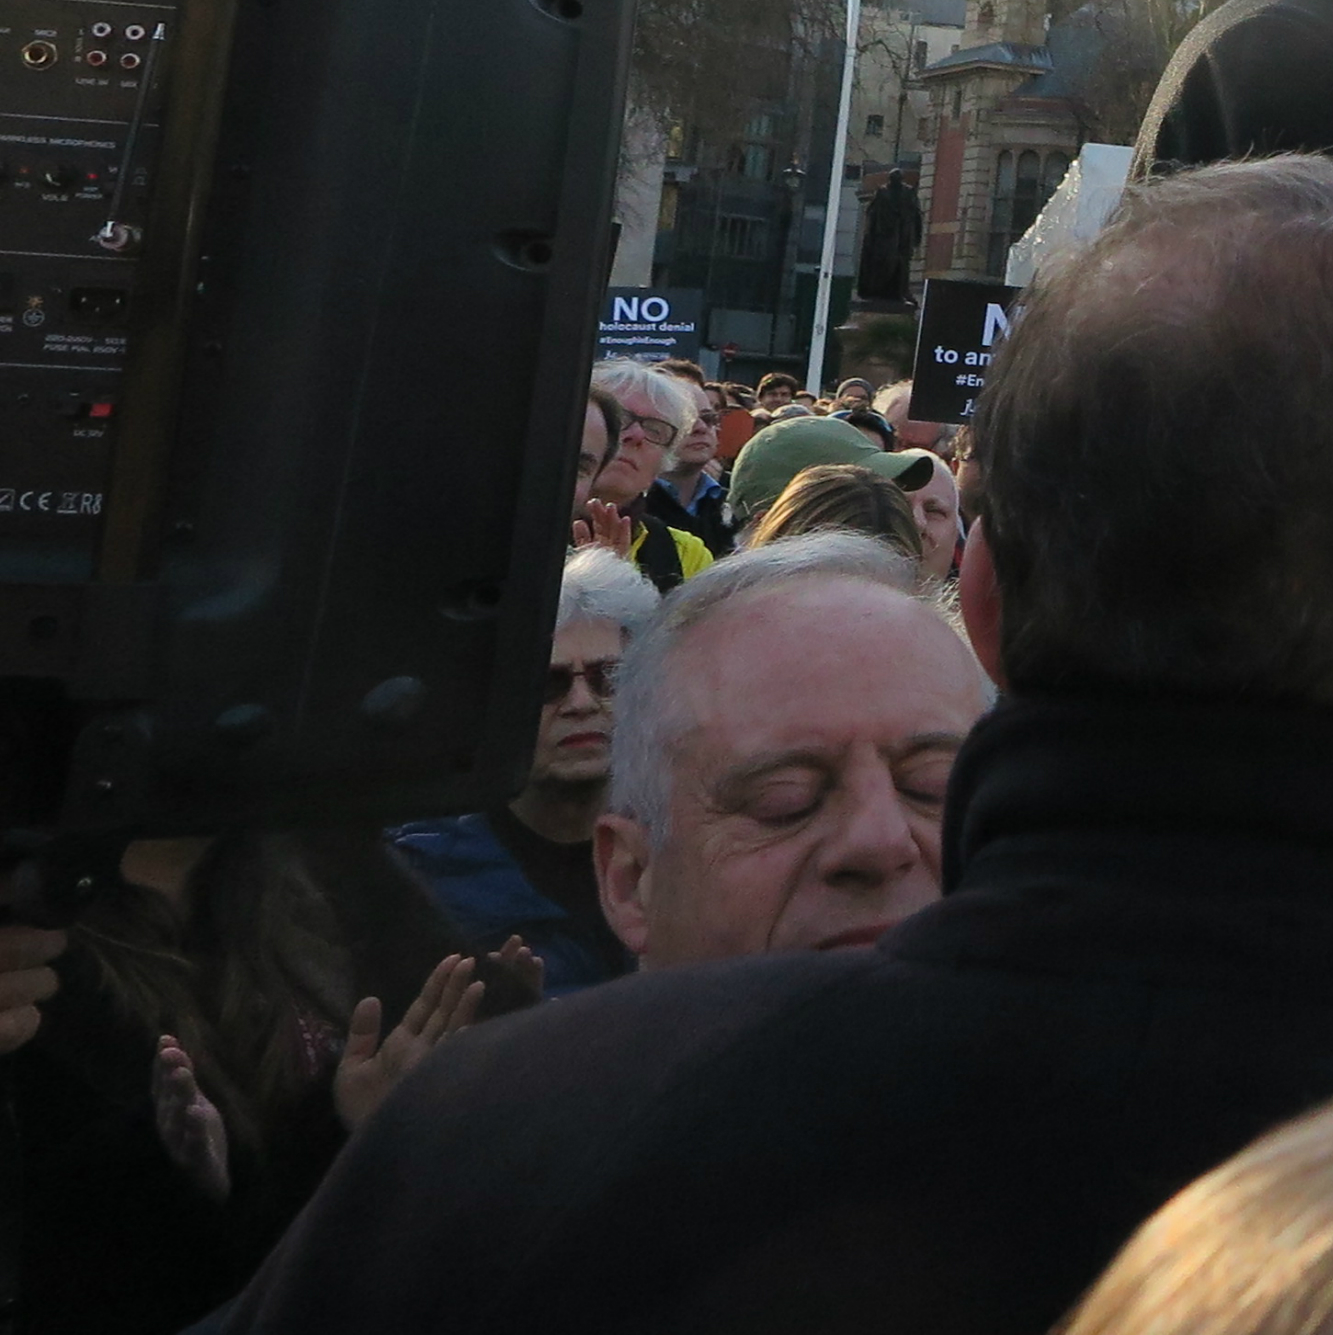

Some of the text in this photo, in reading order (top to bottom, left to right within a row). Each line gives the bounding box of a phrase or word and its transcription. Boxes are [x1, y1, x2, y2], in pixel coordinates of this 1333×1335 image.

[613, 296, 669, 322] NO
[599, 321, 695, 332] holocaust denial
[982, 302, 1026, 347] N
[934, 345, 958, 364] to
